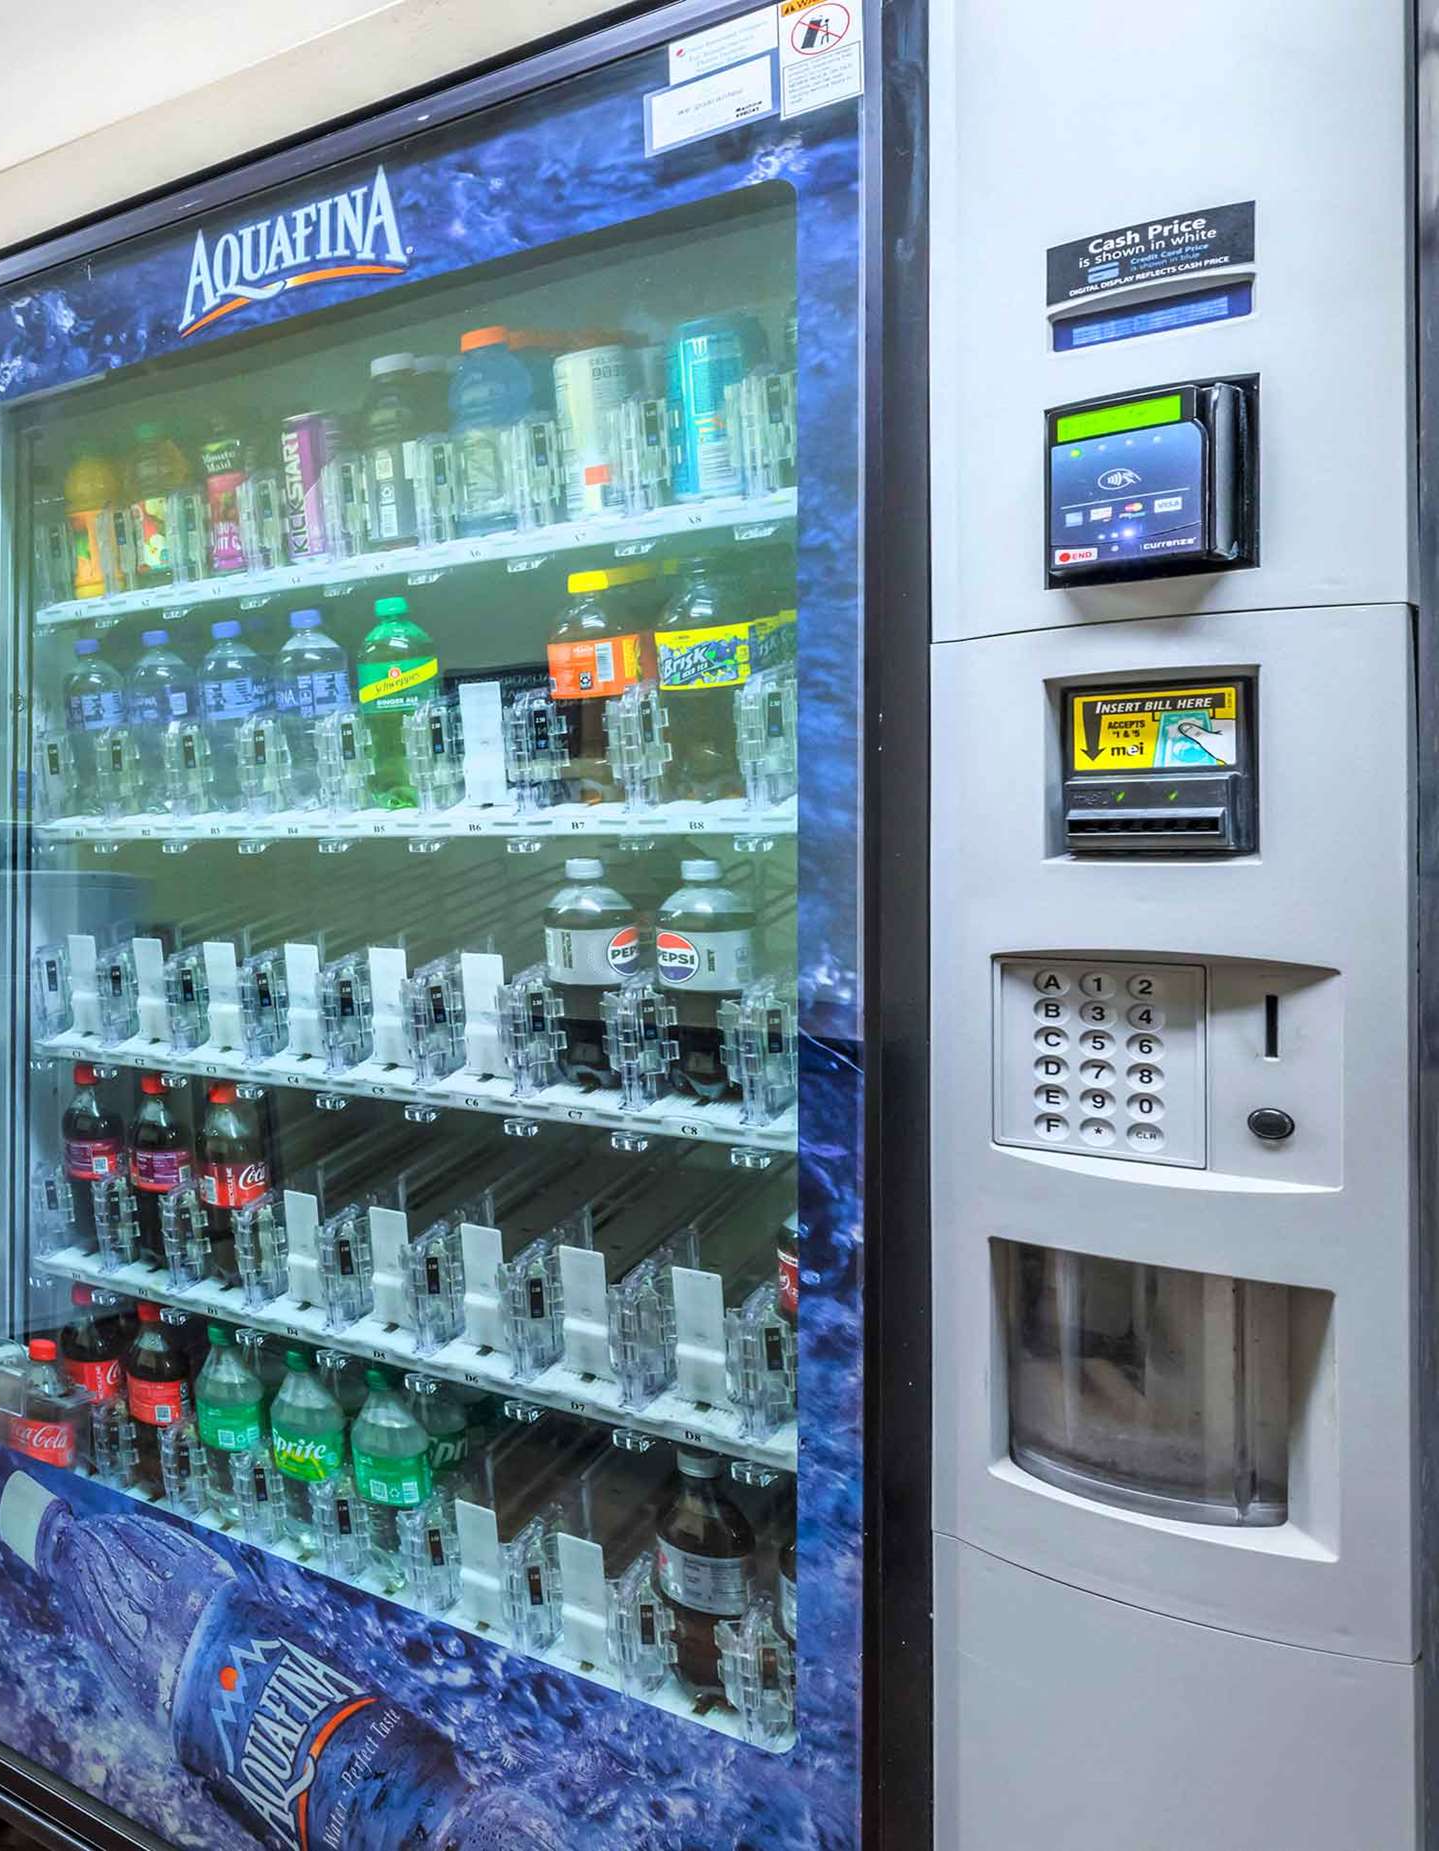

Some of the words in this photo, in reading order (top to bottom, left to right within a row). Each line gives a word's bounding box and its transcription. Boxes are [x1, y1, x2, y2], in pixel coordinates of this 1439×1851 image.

[1088, 231, 1140, 254] Cash
[1148, 218, 1207, 240] Price
[178, 165, 408, 331] AQUAFINA
[1079, 257, 1090, 268] is
[1095, 246, 1145, 264] shown
[1151, 239, 1165, 250] in
[1171, 229, 1217, 245] white
[1185, 243, 1209, 253] Price
[1069, 285, 1099, 297] DIGITAL
[1100, 276, 1134, 288] DISPLAY
[1136, 267, 1177, 280] REFLECTS
[1177, 262, 1202, 271] CASH
[1204, 256, 1230, 266] PRICE
[282, 432, 309, 554] KICKSTART
[1143, 538, 1195, 550] currenza
[1072, 551, 1092, 560] END
[1096, 701, 1143, 714] INSERT
[1144, 701, 1172, 710] BILL
[1177, 697, 1212, 709] HERE
[1108, 720, 1145, 729] ACCEPTS
[1111, 742, 1144, 756] mei
[571, 822, 584, 830] B7
[689, 821, 704, 829] B8
[1044, 975, 1060, 989] A
[1094, 978, 1103, 991] 1
[1139, 980, 1152, 994] 2
[1045, 1005, 1060, 1018] B
[1092, 1007, 1105, 1021] 3
[1139, 1009, 1152, 1024] 4
[1044, 1032, 1060, 1047] C
[1092, 1036, 1105, 1051] 5
[1139, 1039, 1152, 1055] 6
[1045, 1062, 1060, 1076] D
[1092, 1065, 1105, 1079] 7
[287, 1076, 298, 1084] C4
[1139, 1070, 1152, 1085] 8
[372, 1087, 384, 1095] C5
[1045, 1090, 1060, 1104] E
[465, 1098, 478, 1107] C6
[1092, 1095, 1105, 1109] 9
[1140, 1099, 1152, 1114] 0
[568, 1110, 582, 1120] C7
[681, 1126, 697, 1136] C8
[1046, 1119, 1060, 1133] F
[1136, 1131, 1157, 1140] CLR
[287, 1327, 298, 1336] D4
[373, 1351, 385, 1360] D5
[465, 1374, 478, 1383] D6
[570, 1401, 584, 1411] D7
[685, 1431, 701, 1442] D8
[226, 1636, 370, 1851] AQUAFINA
[322, 1799, 348, 1850] Water
[341, 1735, 380, 1790] Perfect
[370, 1708, 401, 1739] Taste
